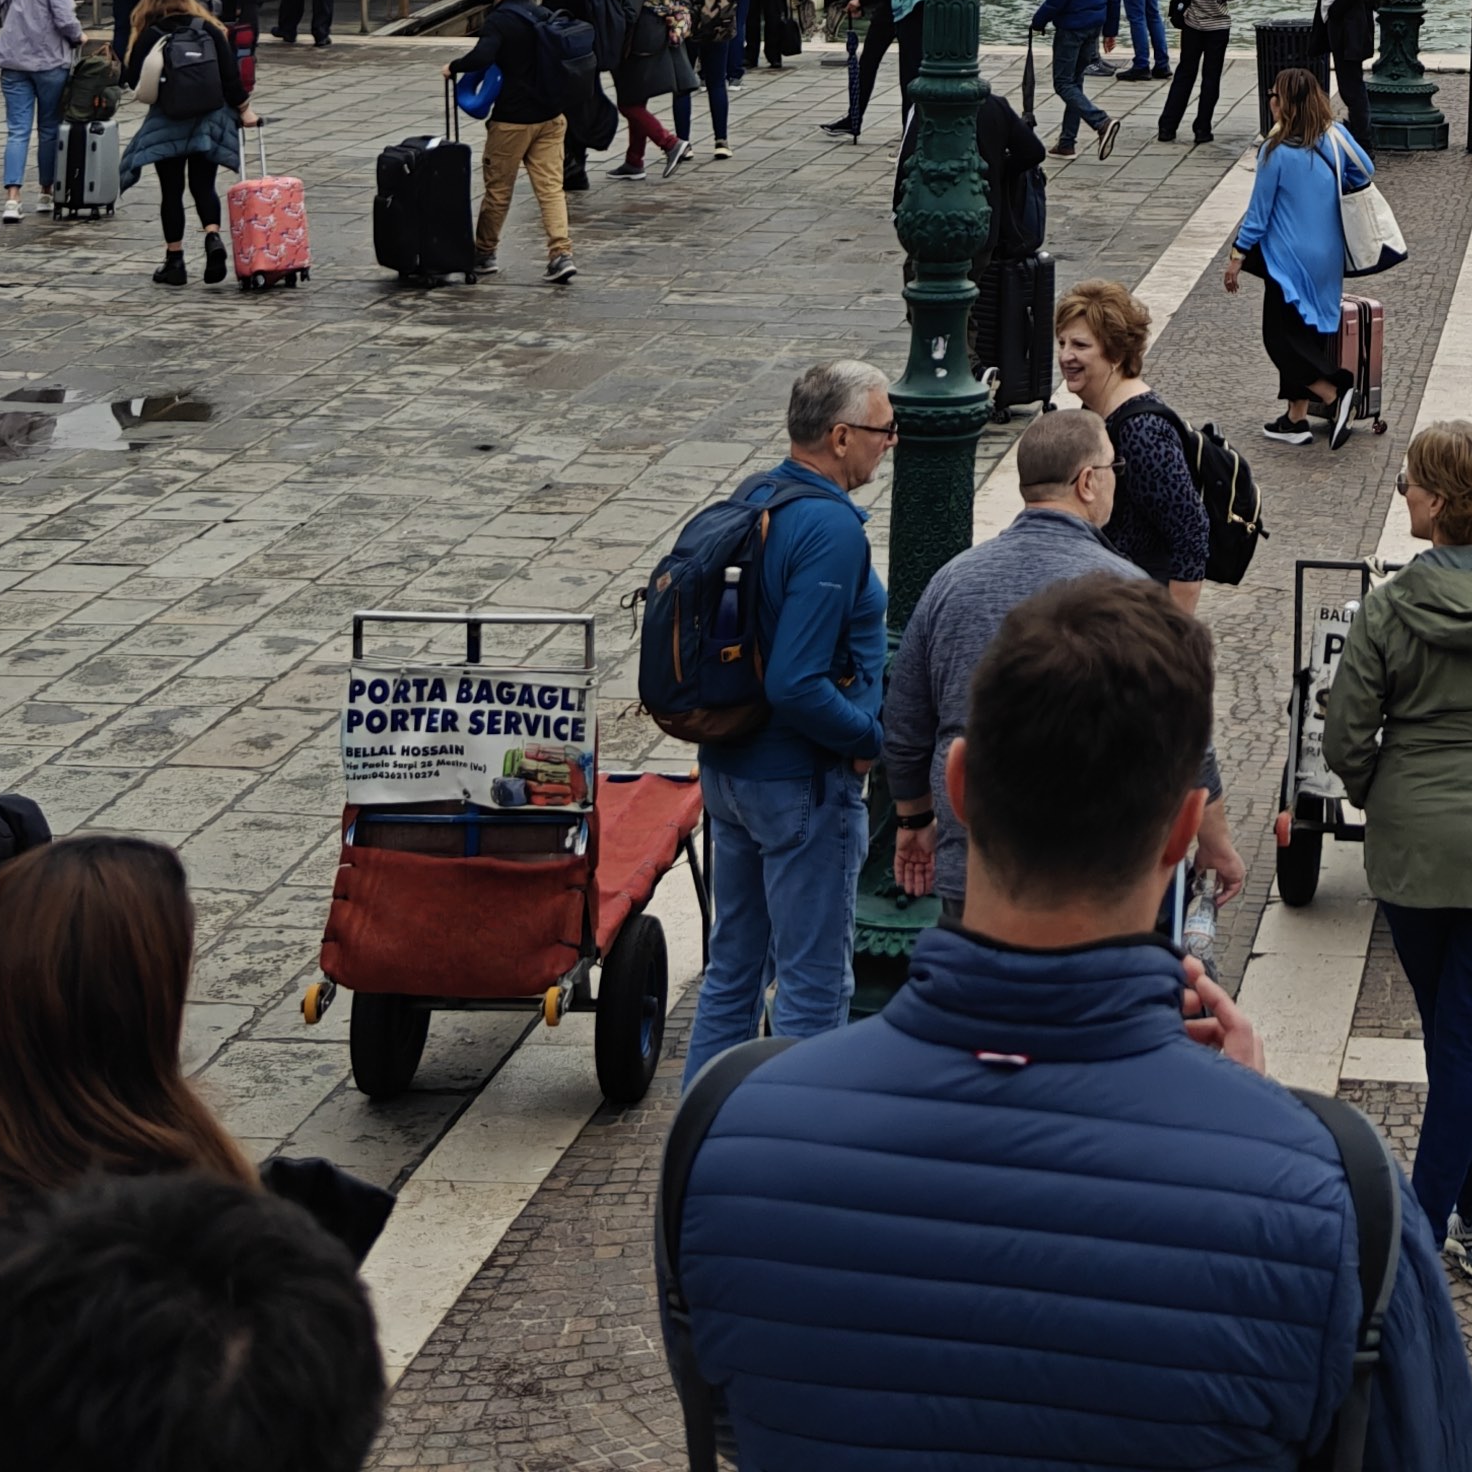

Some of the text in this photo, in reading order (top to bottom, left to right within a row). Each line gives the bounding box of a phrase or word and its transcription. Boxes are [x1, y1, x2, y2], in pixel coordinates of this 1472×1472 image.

[349, 678, 448, 704] PORTA
[347, 708, 586, 742] PORTER SERVICE
[346, 744, 464, 758] BELLAL HOSSAIN
[362, 760, 390, 770] Paolo
[393, 760, 418, 771] Sarpi
